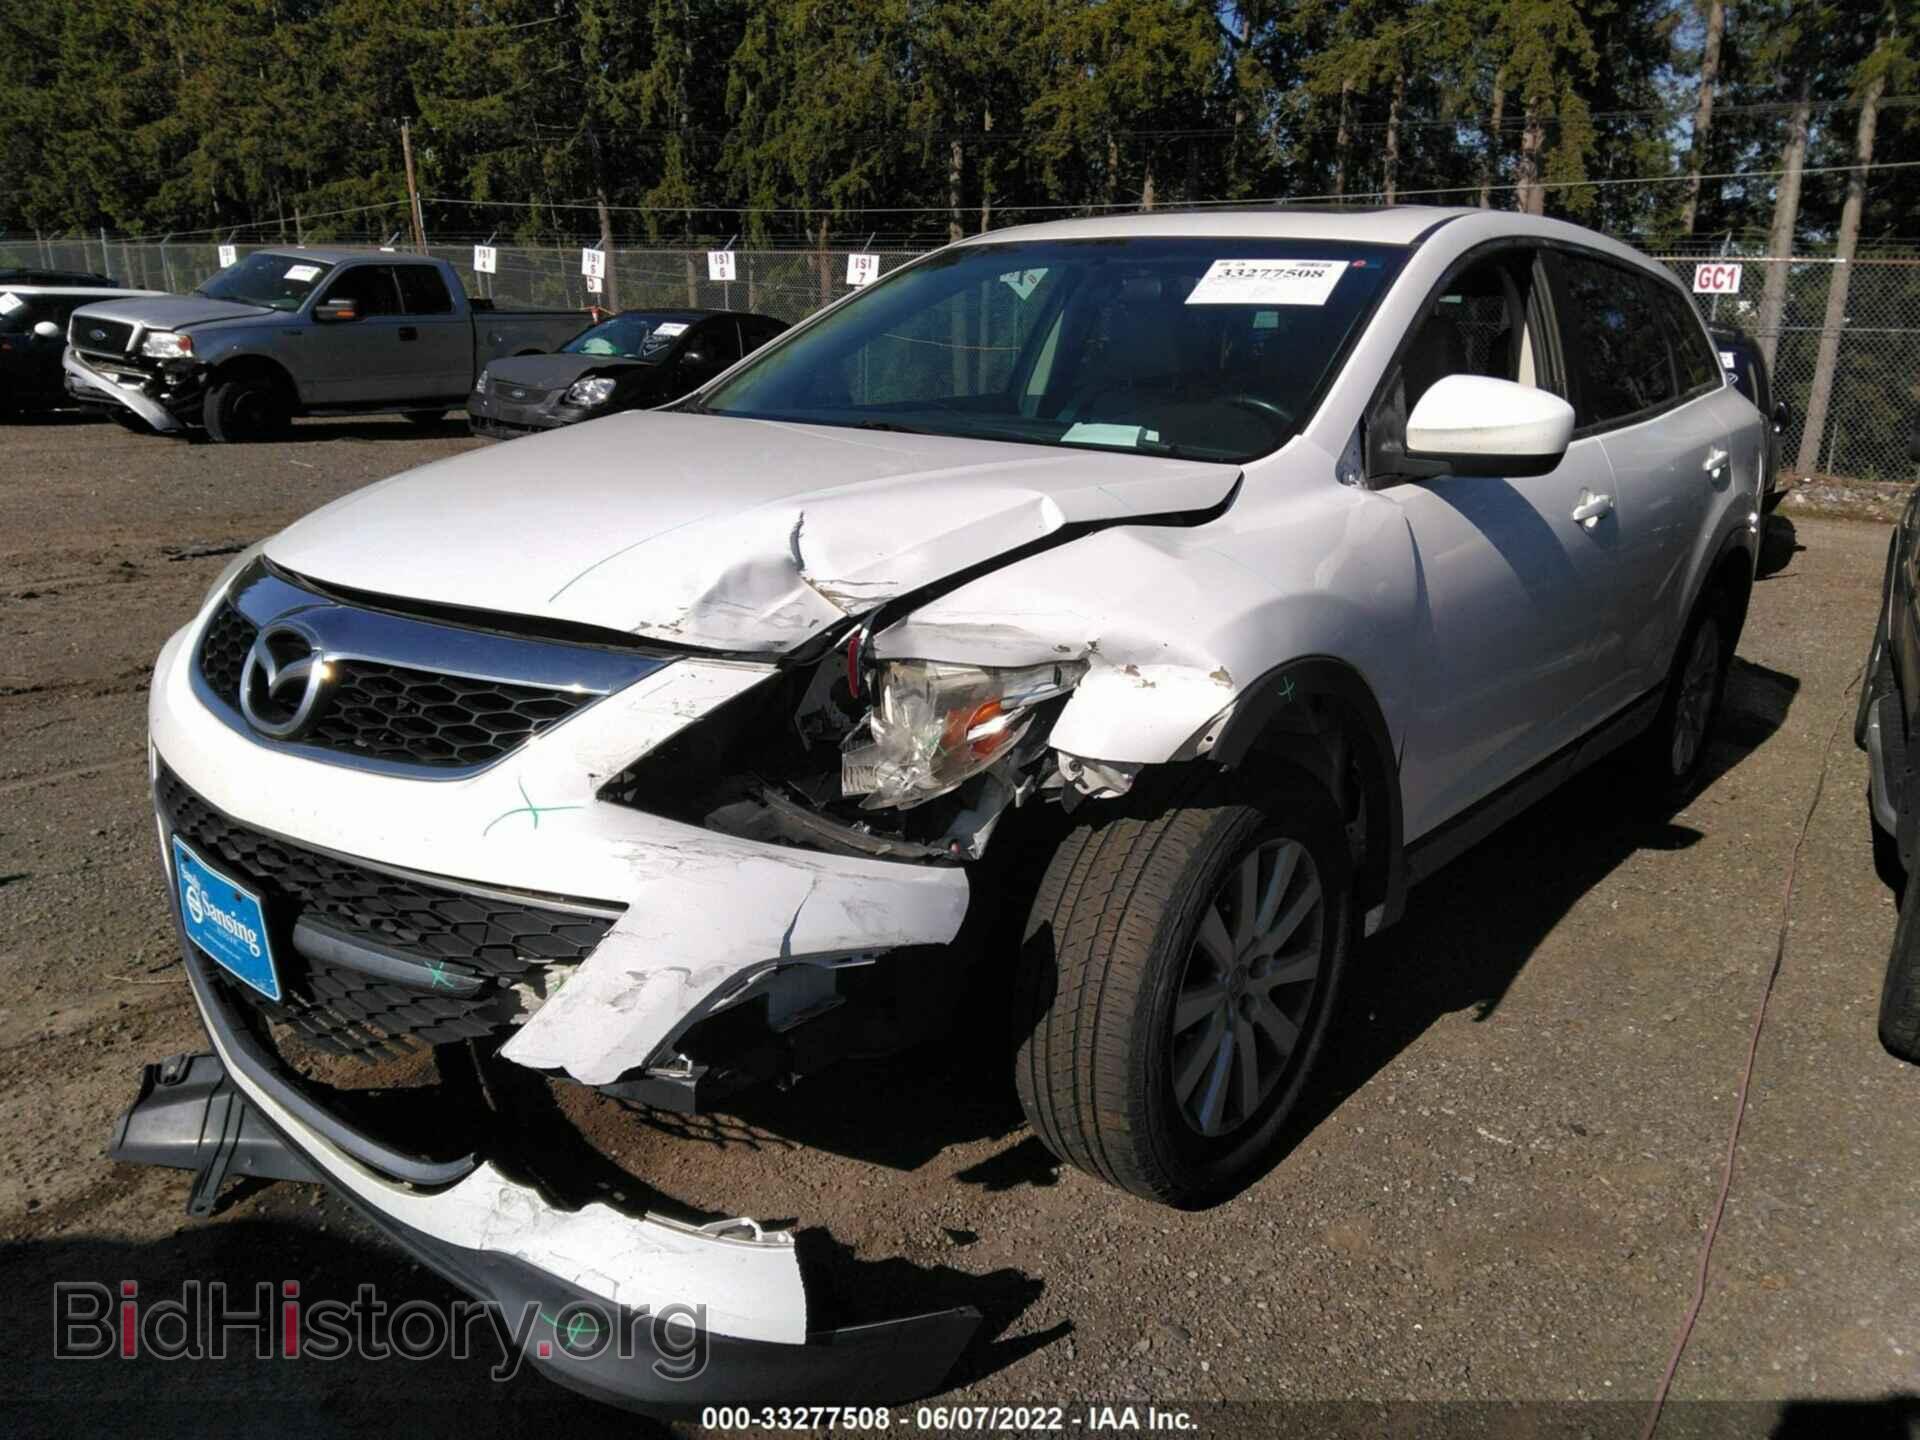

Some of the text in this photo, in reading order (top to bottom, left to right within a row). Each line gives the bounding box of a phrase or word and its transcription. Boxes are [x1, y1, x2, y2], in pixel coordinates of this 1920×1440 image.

[859, 272, 866, 283] 7
[1217, 267, 1325, 280] 33277508
[1698, 266, 1736, 290] GC1
[202, 890, 261, 958] Sansing
